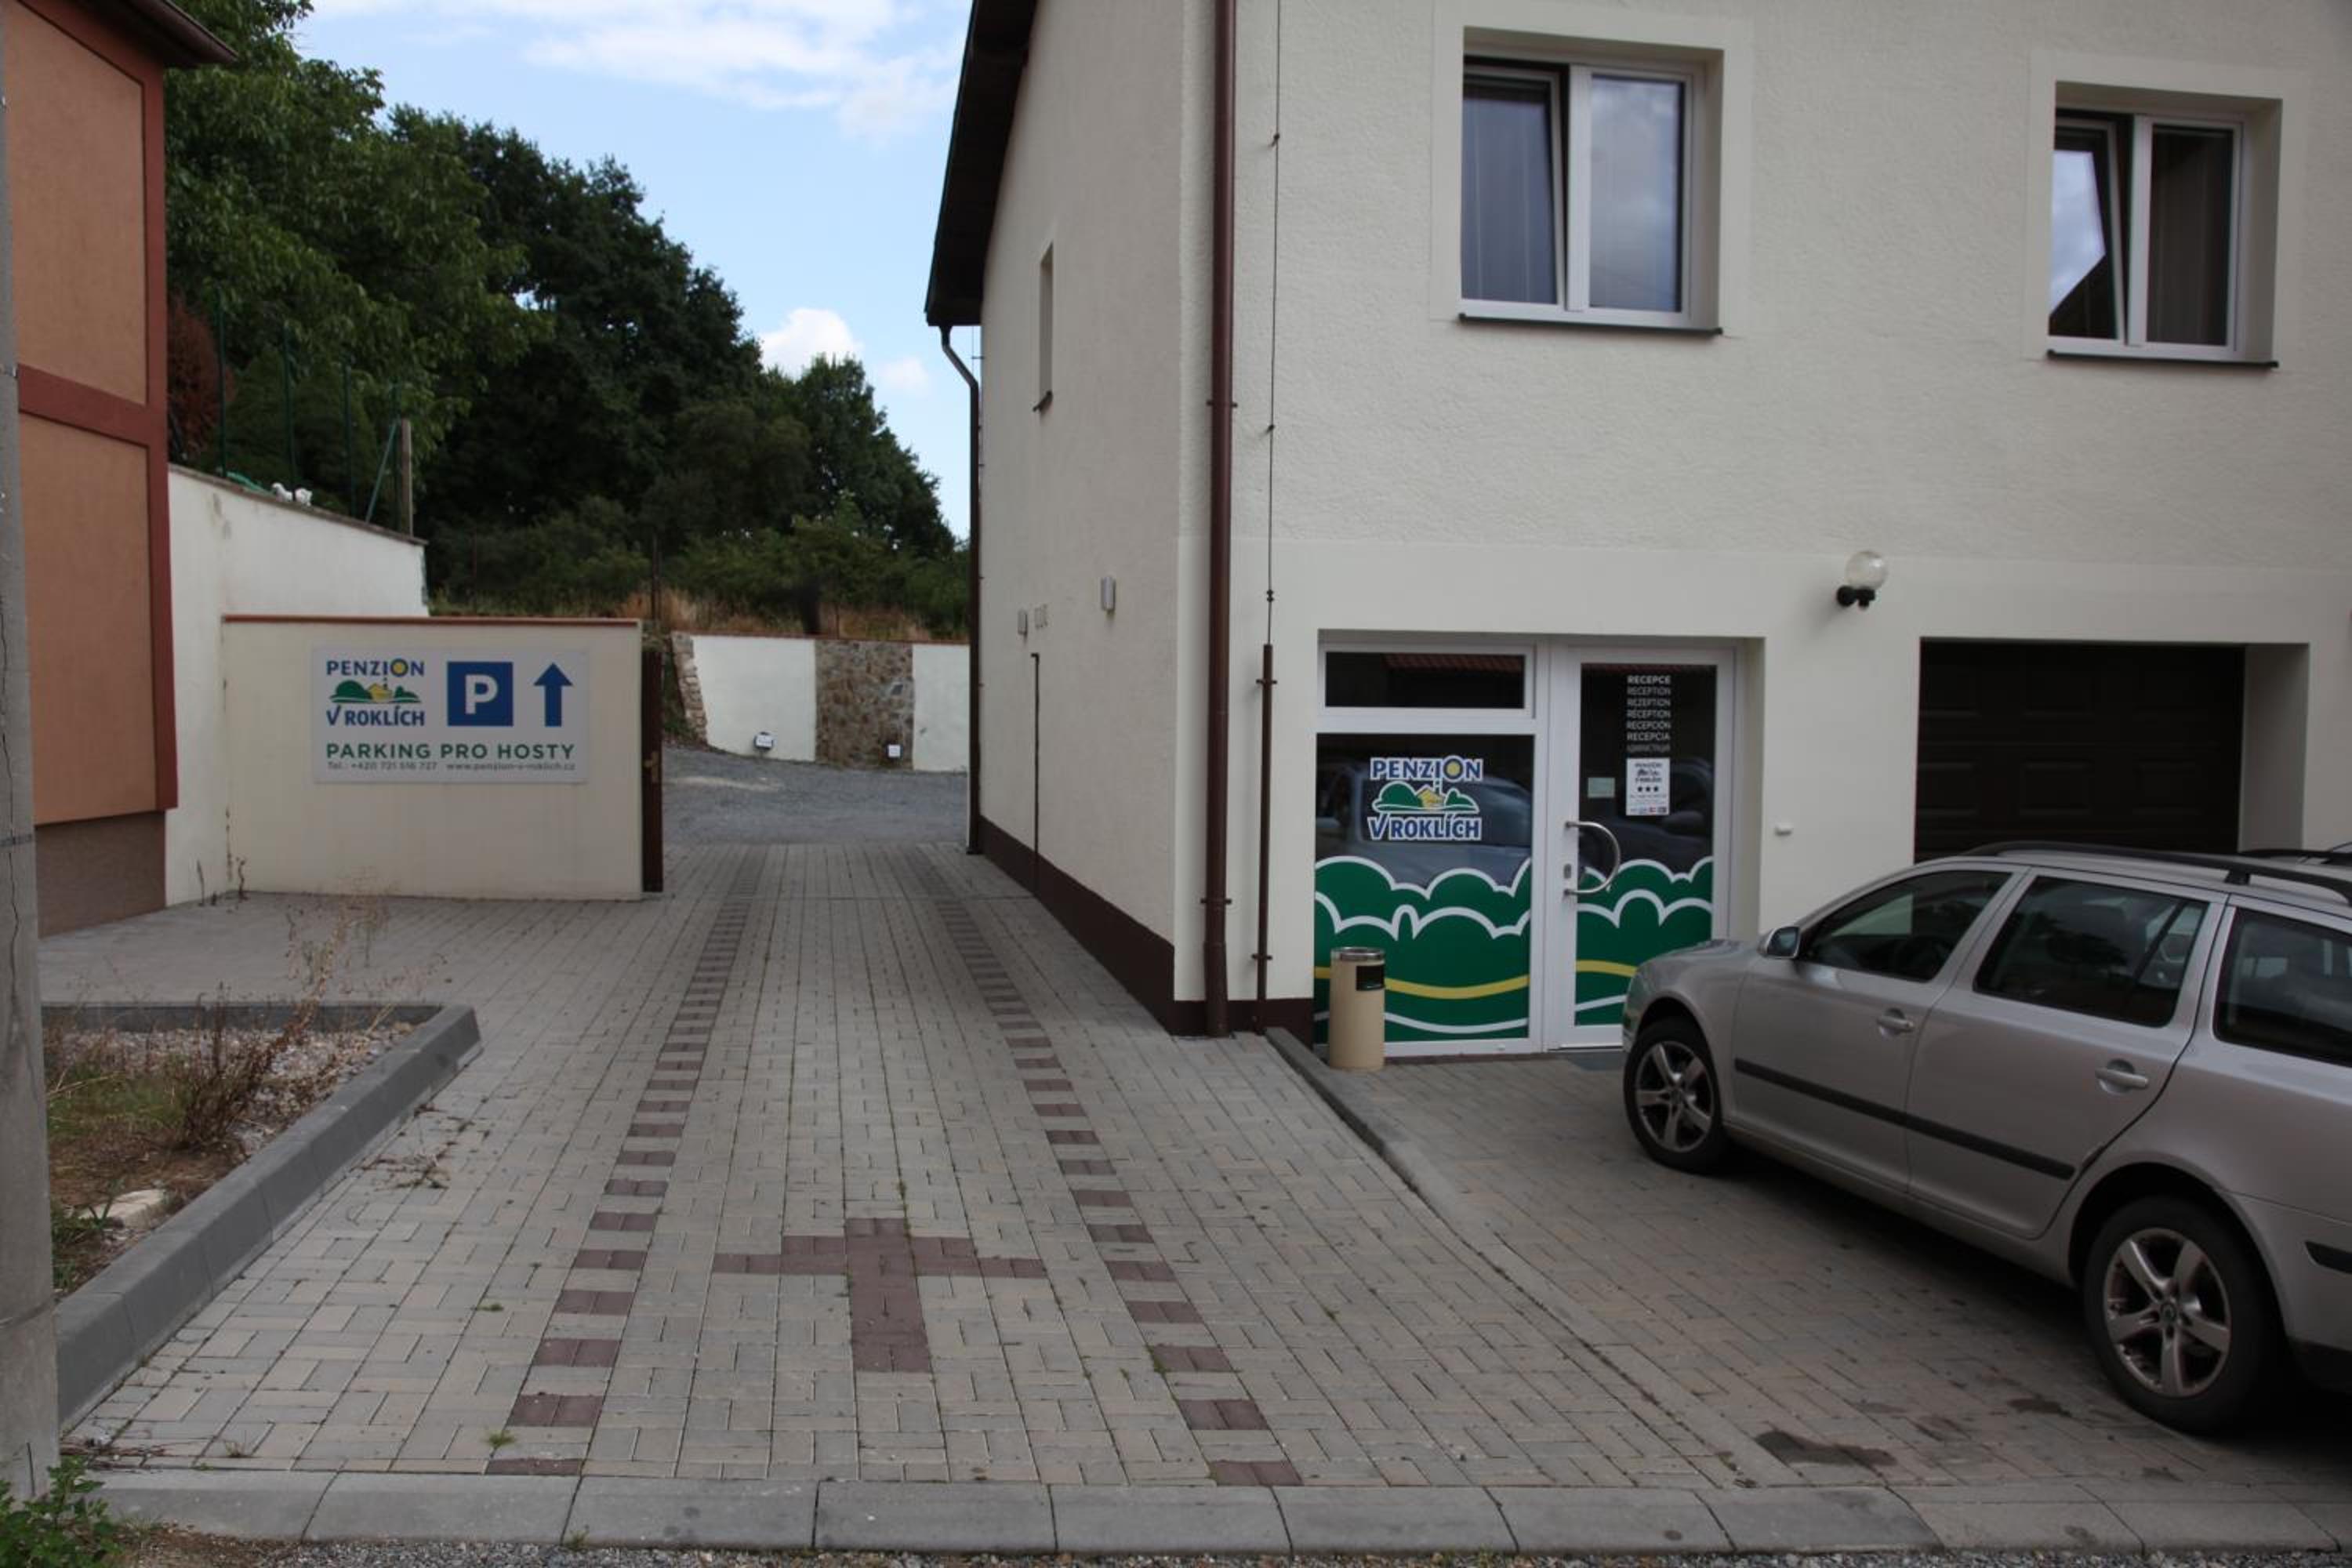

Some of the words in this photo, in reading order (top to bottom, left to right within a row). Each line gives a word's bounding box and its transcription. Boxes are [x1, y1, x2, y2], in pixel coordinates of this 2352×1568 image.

[326, 659, 425, 677] PENZION
[1627, 675, 1671, 684] RECEPCE
[465, 673, 499, 715] P
[1627, 686, 1671, 695] RECEPTION
[326, 705, 342, 726] V
[345, 706, 425, 726] ROKLÍCH
[326, 743, 431, 759] PARKING
[441, 743, 488, 759] PRO
[497, 743, 575, 760] HOSTY
[1372, 757, 1482, 780] PENZION
[1368, 813, 1388, 839] V
[1390, 813, 1480, 839] ROKLÍCH
